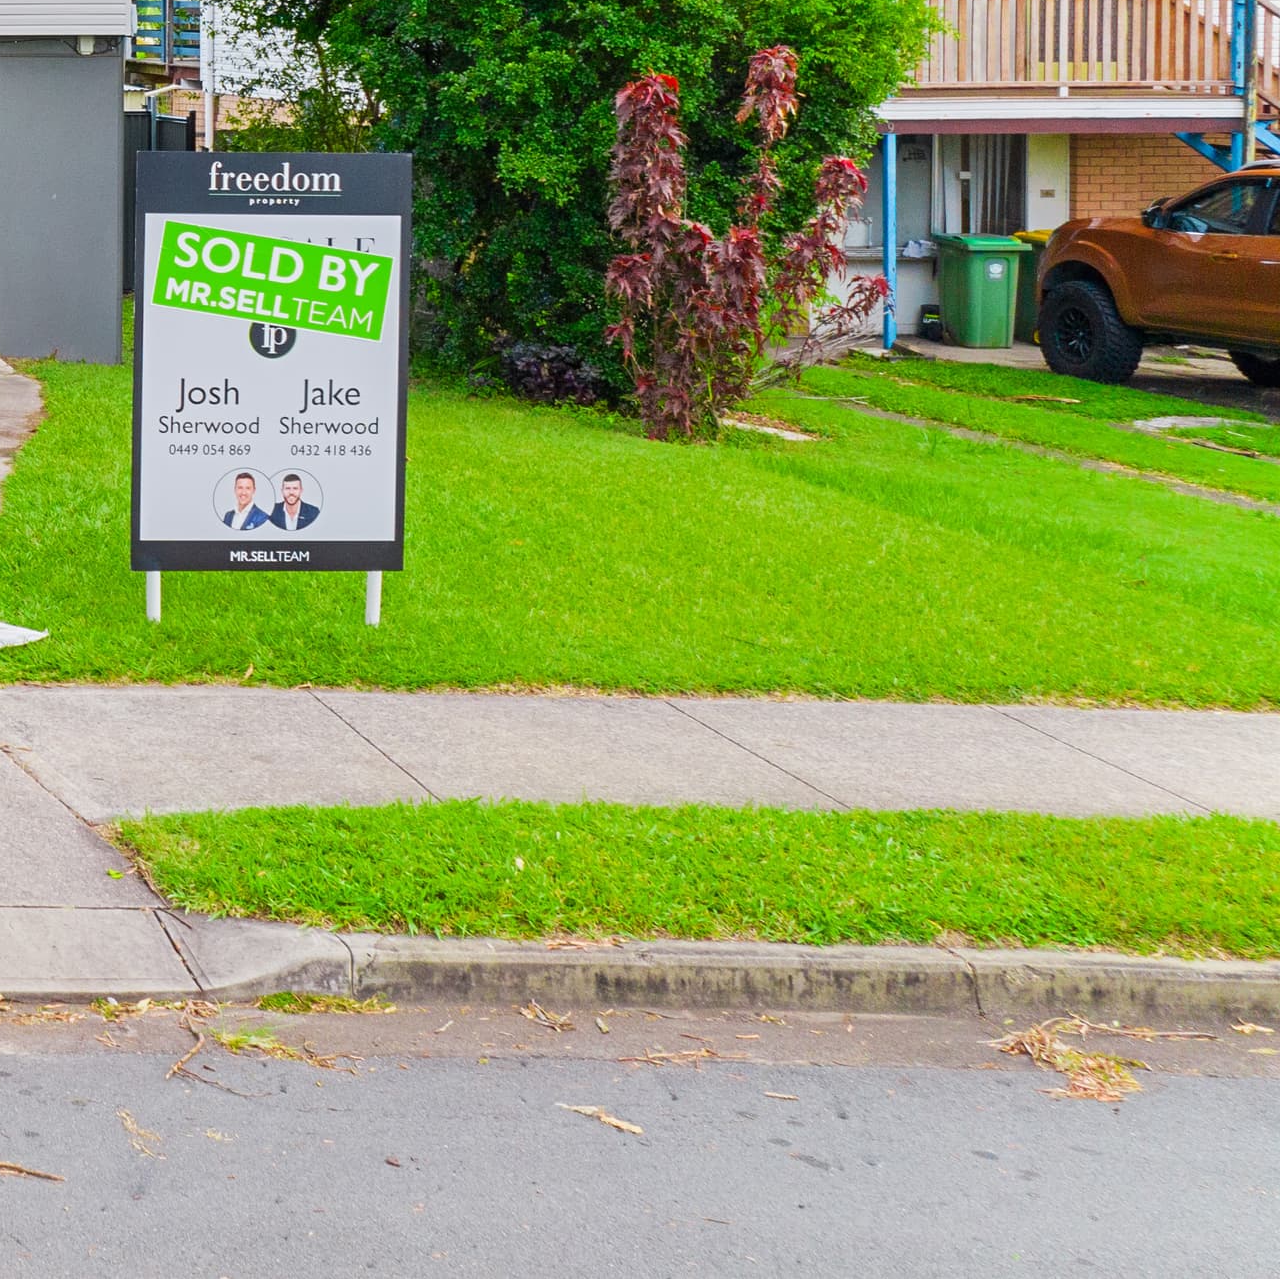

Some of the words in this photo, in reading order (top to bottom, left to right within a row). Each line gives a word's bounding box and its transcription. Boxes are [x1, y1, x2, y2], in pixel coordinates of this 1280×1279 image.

[208, 161, 342, 192] freedom
[249, 197, 300, 206] property
[173, 231, 304, 284] SOLD
[318, 254, 380, 296] BY
[175, 378, 239, 413] Josh
[299, 379, 361, 414] Jake
[158, 415, 260, 434] Sherwood
[279, 416, 379, 435] Sherwood
[169, 444, 198, 455] 0449
[202, 444, 224, 455] 054
[229, 444, 251, 456] 869
[290, 445, 320, 456] 0432
[324, 445, 346, 456] 418
[350, 445, 372, 456] 436
